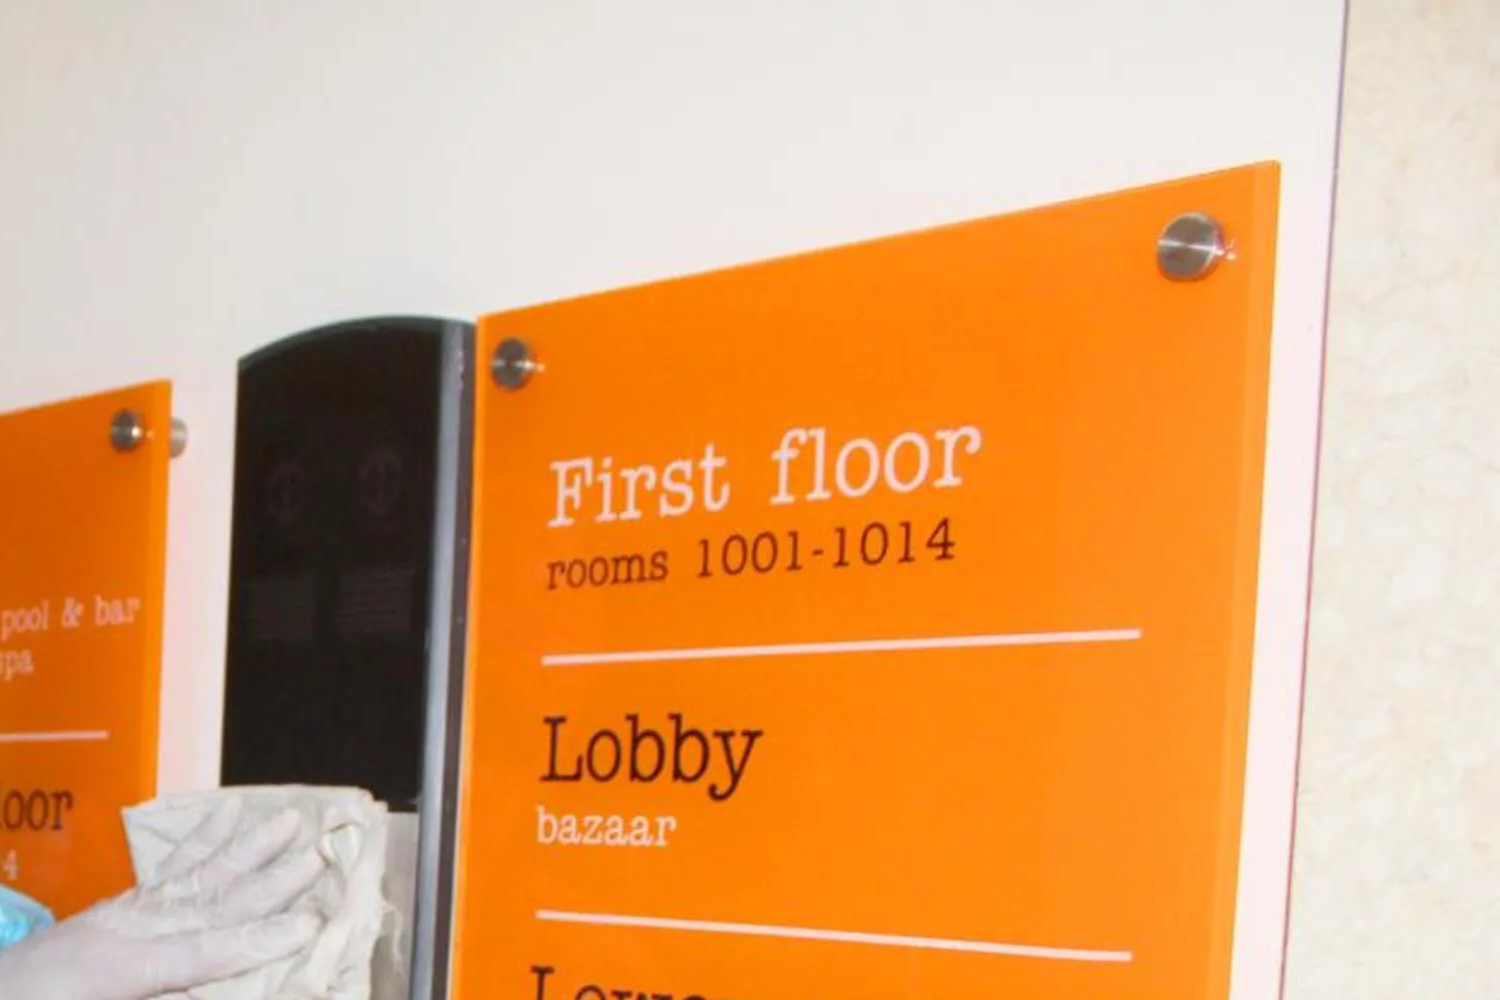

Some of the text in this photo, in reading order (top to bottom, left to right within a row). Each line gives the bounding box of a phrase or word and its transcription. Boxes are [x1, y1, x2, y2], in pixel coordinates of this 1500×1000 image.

[546, 424, 982, 528] First floor
[546, 516, 957, 591] rooms 1001-1014
[62, 598, 84, 628] &
[94, 595, 142, 627] bar
[540, 713, 763, 801] Lobby
[536, 805, 678, 847] bazaar
